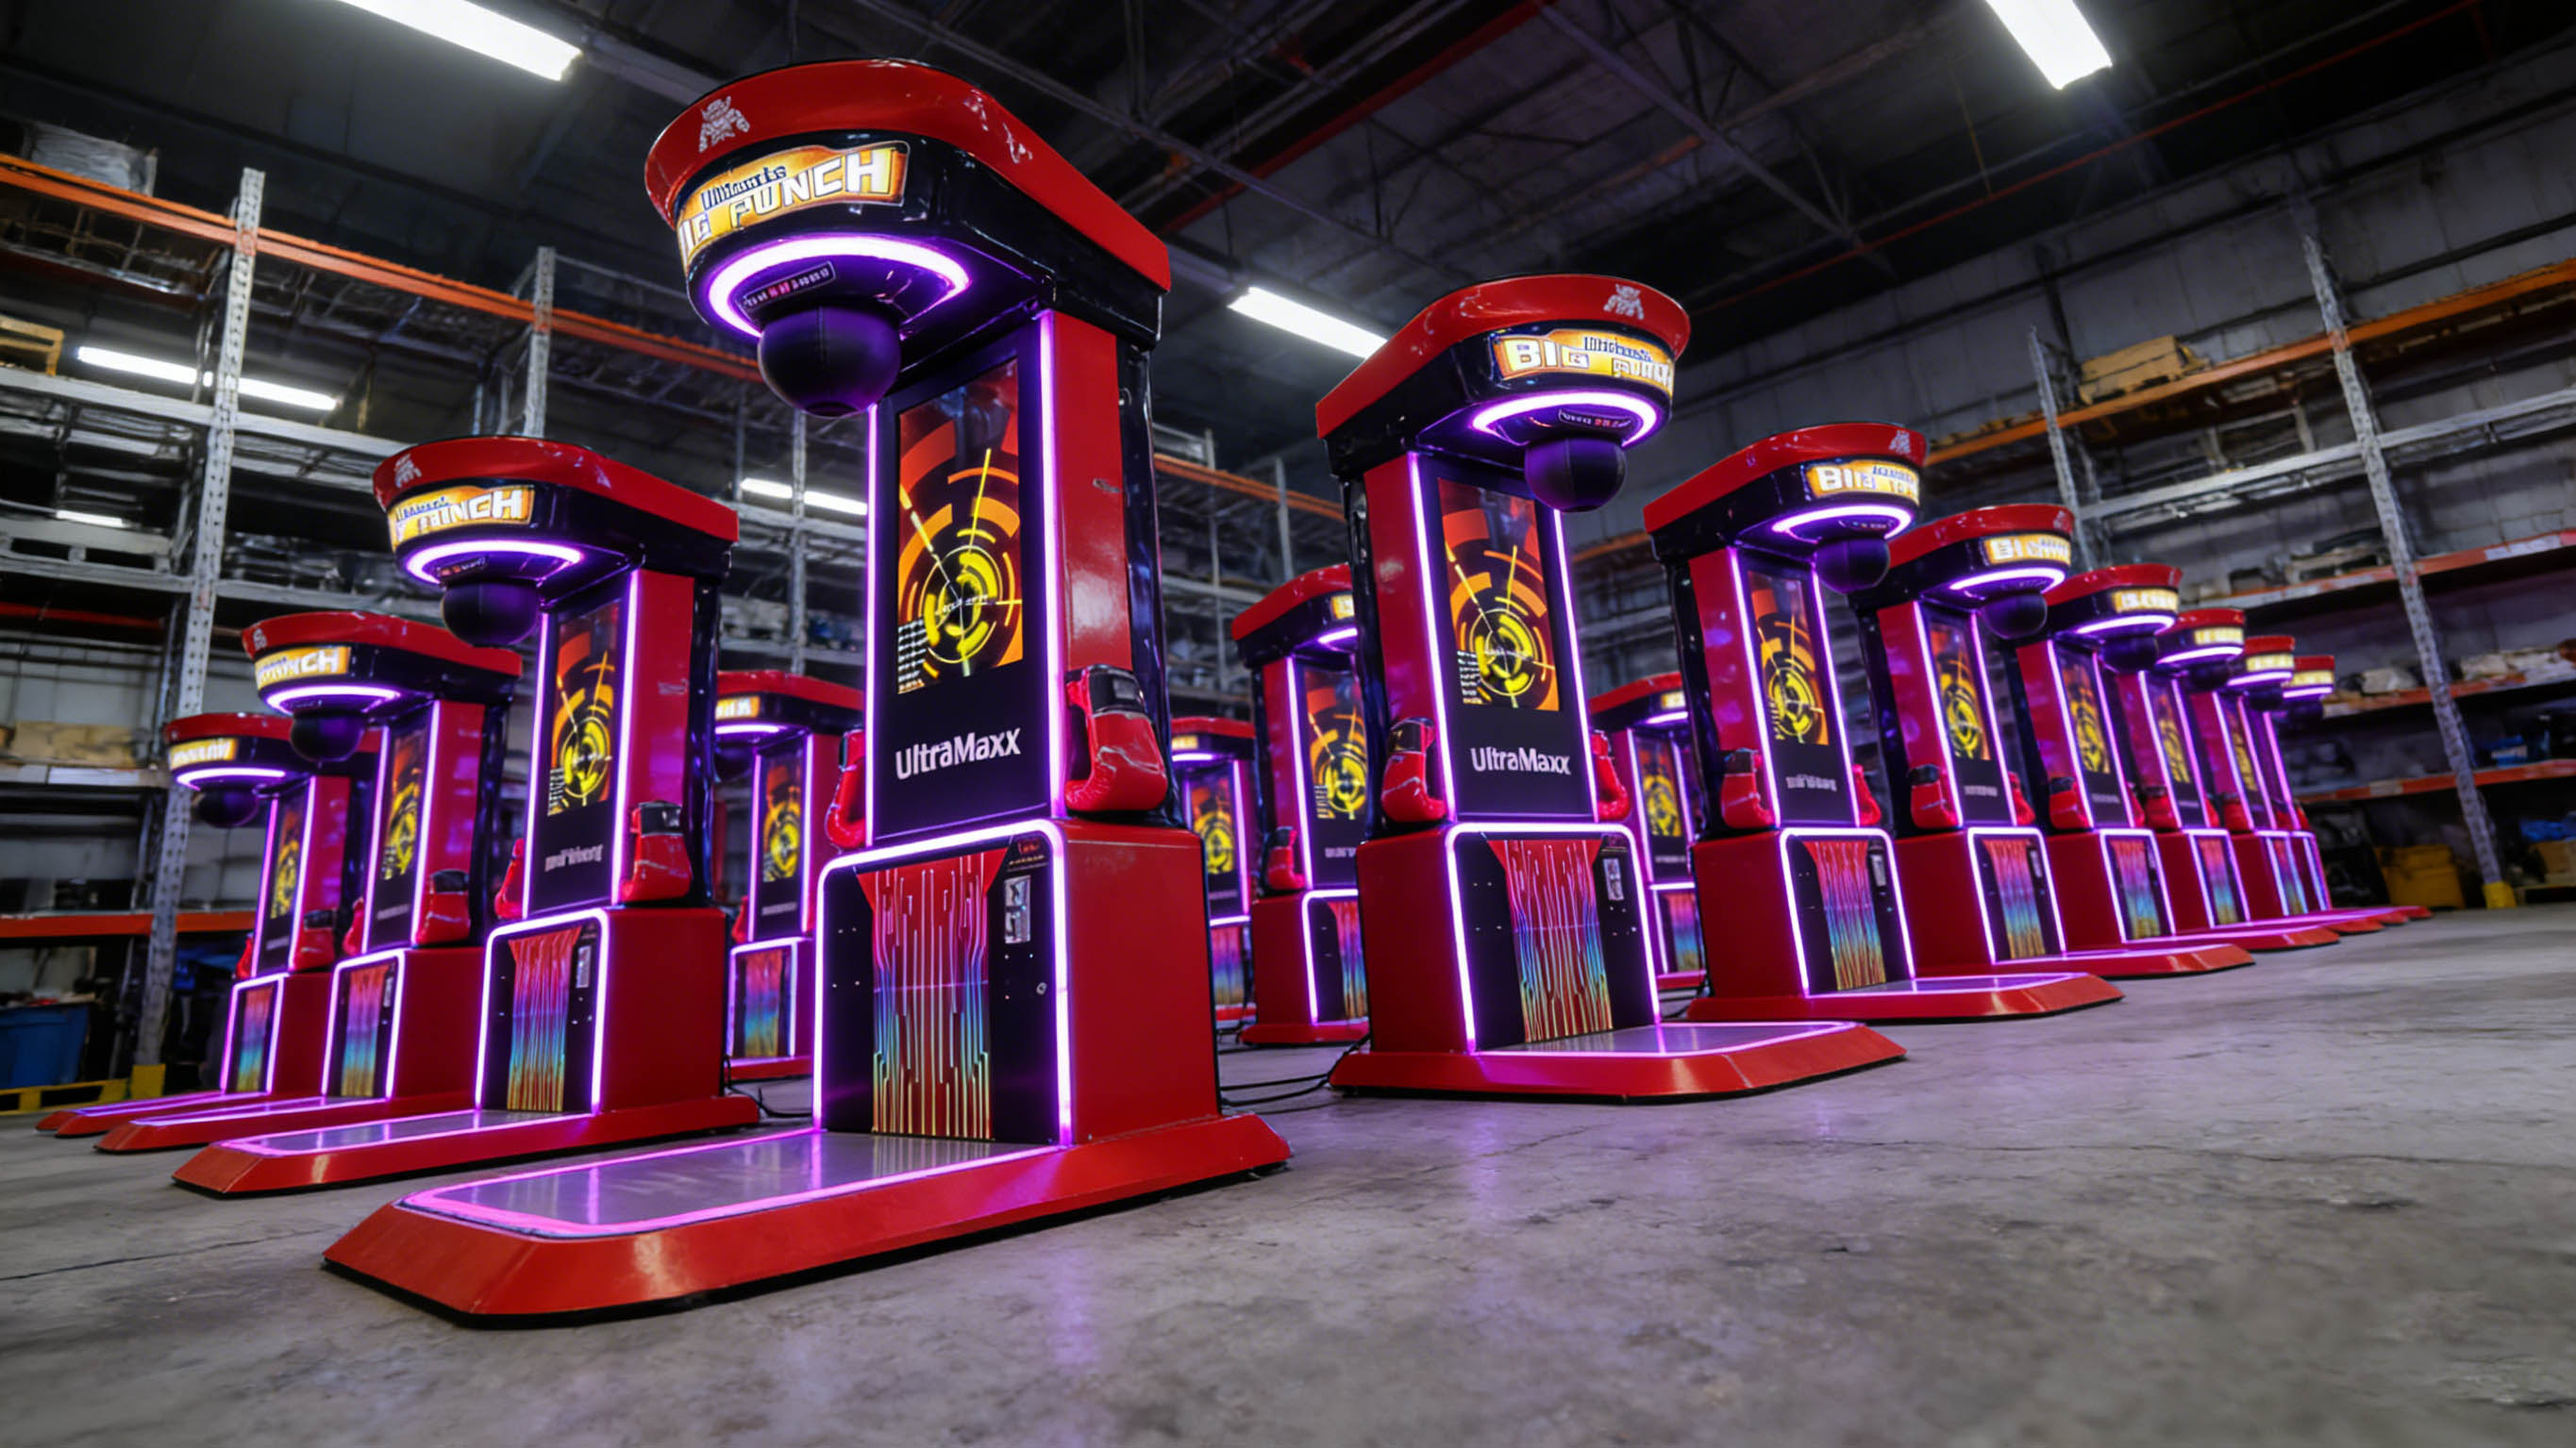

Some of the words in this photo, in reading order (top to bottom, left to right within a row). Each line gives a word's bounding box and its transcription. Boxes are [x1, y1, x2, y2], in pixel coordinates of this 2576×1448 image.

[729, 148, 893, 229] PUNCH
[895, 727, 1021, 780] UltraMaxx
[1470, 746, 1572, 776] UltraMaxx
